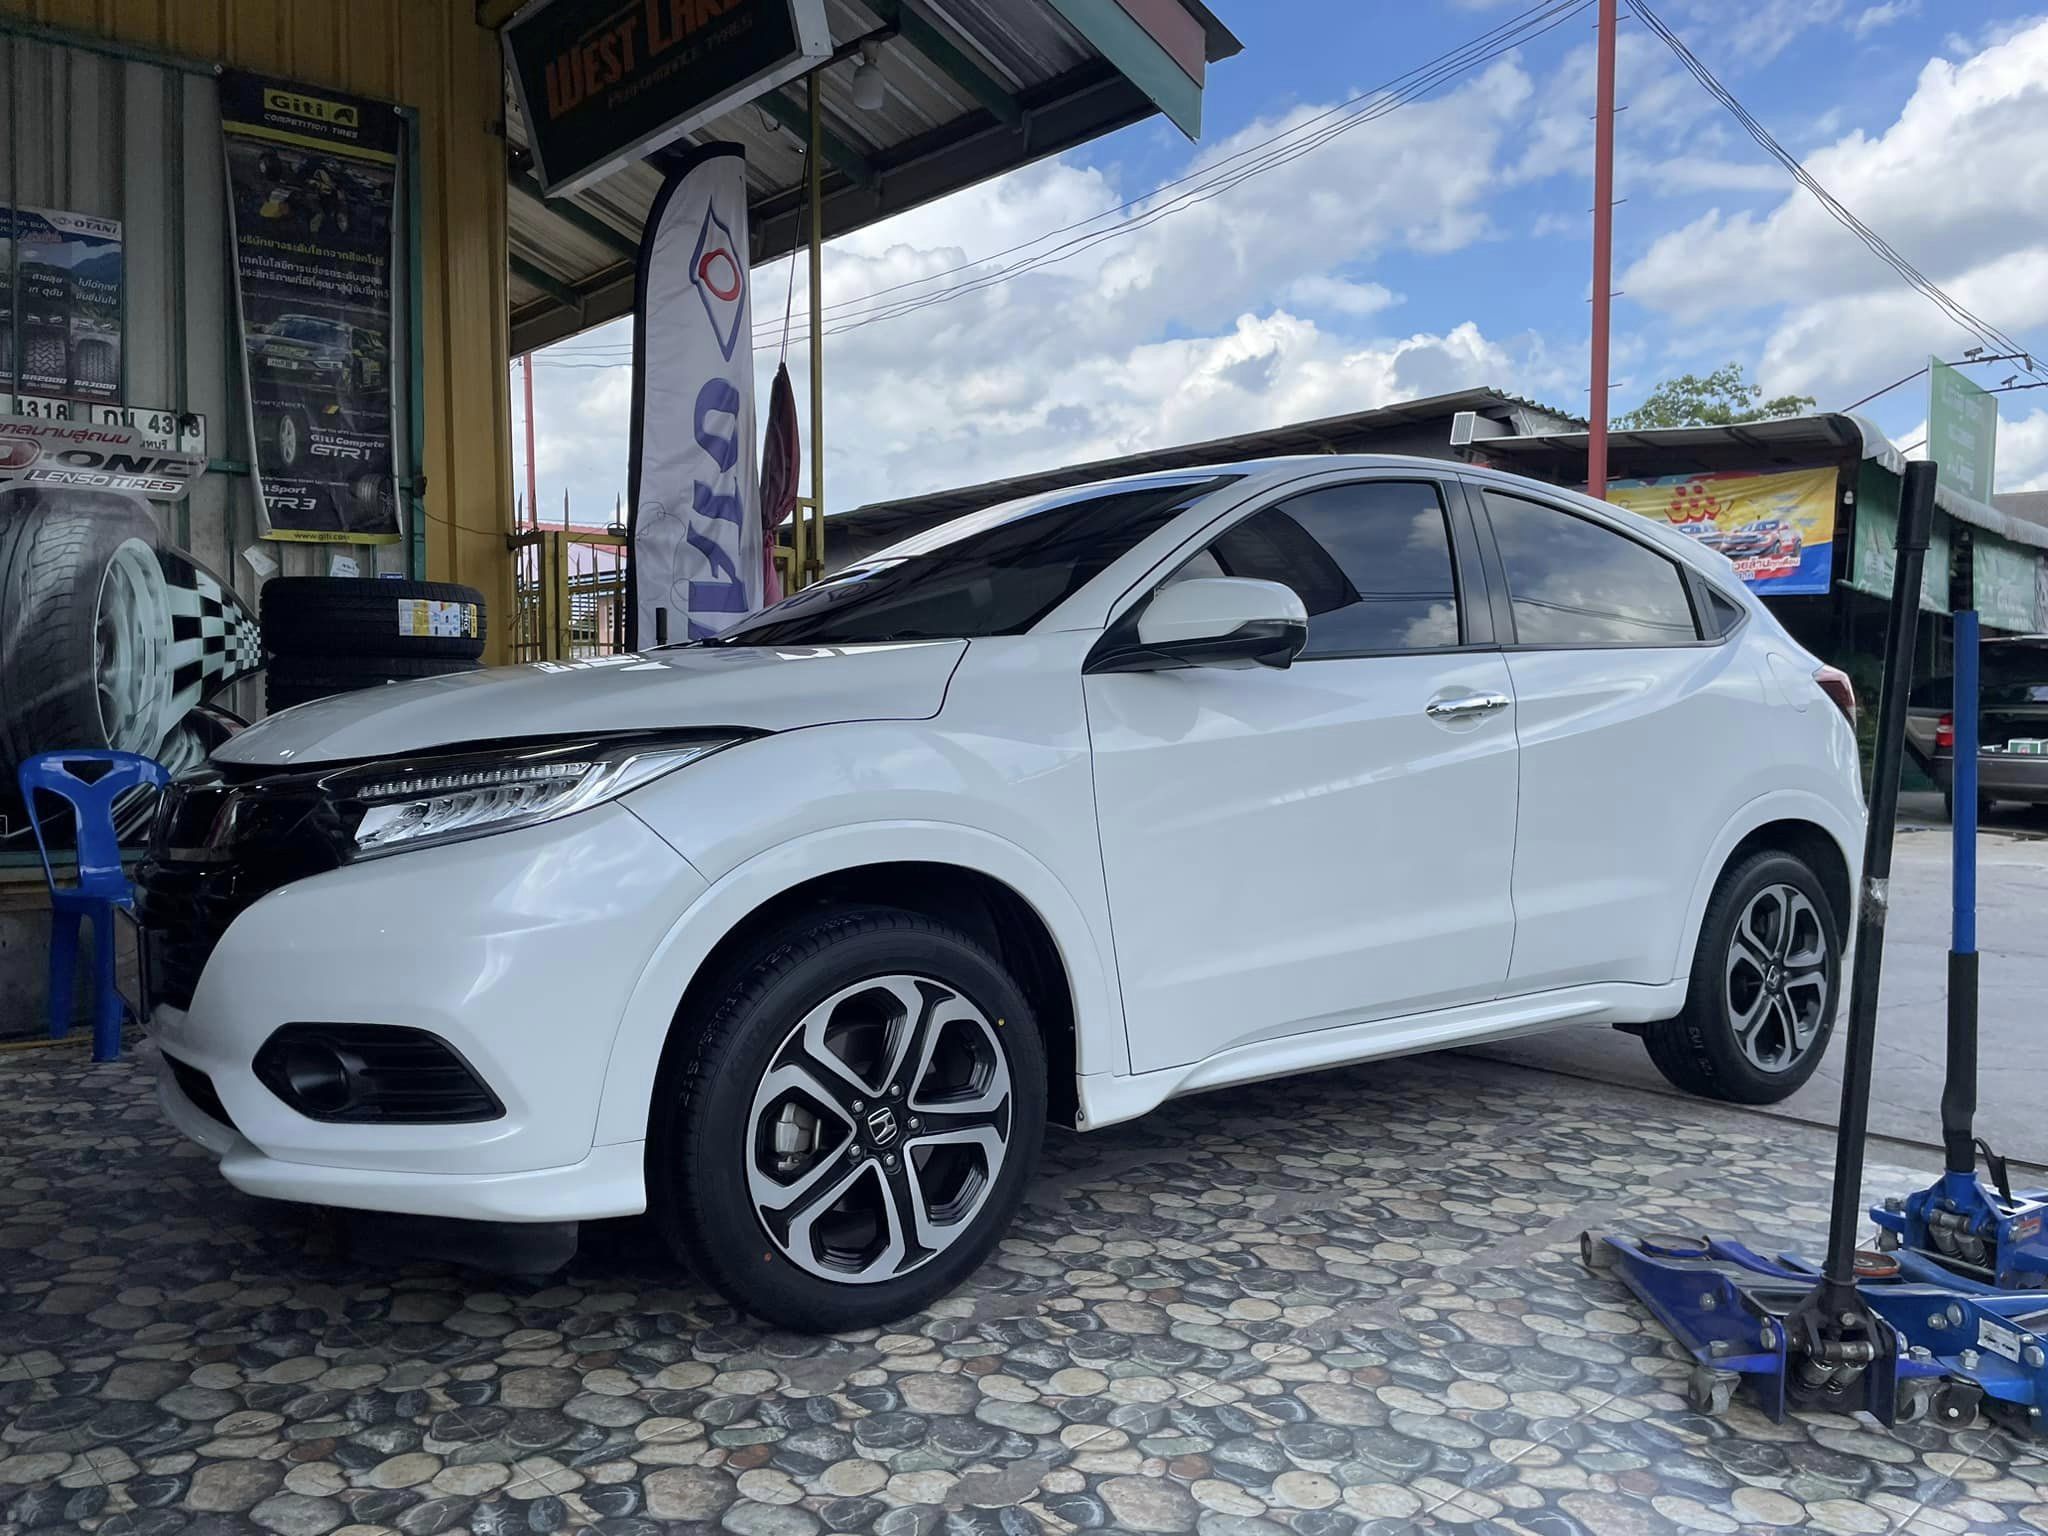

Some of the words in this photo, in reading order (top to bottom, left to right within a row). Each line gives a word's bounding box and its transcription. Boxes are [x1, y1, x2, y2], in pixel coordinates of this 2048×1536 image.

[545, 15, 637, 121] WEST
[646, 0, 743, 55] LAK
[270, 95, 324, 118] Giti
[332, 127, 359, 139] TIRES
[73, 219, 118, 235] OTANI
[29, 469, 106, 486] LENSO
[113, 475, 184, 493] TIRES
[270, 484, 307, 495] Sport
[264, 496, 317, 511] TR3
[686, 377, 748, 640] OTA
